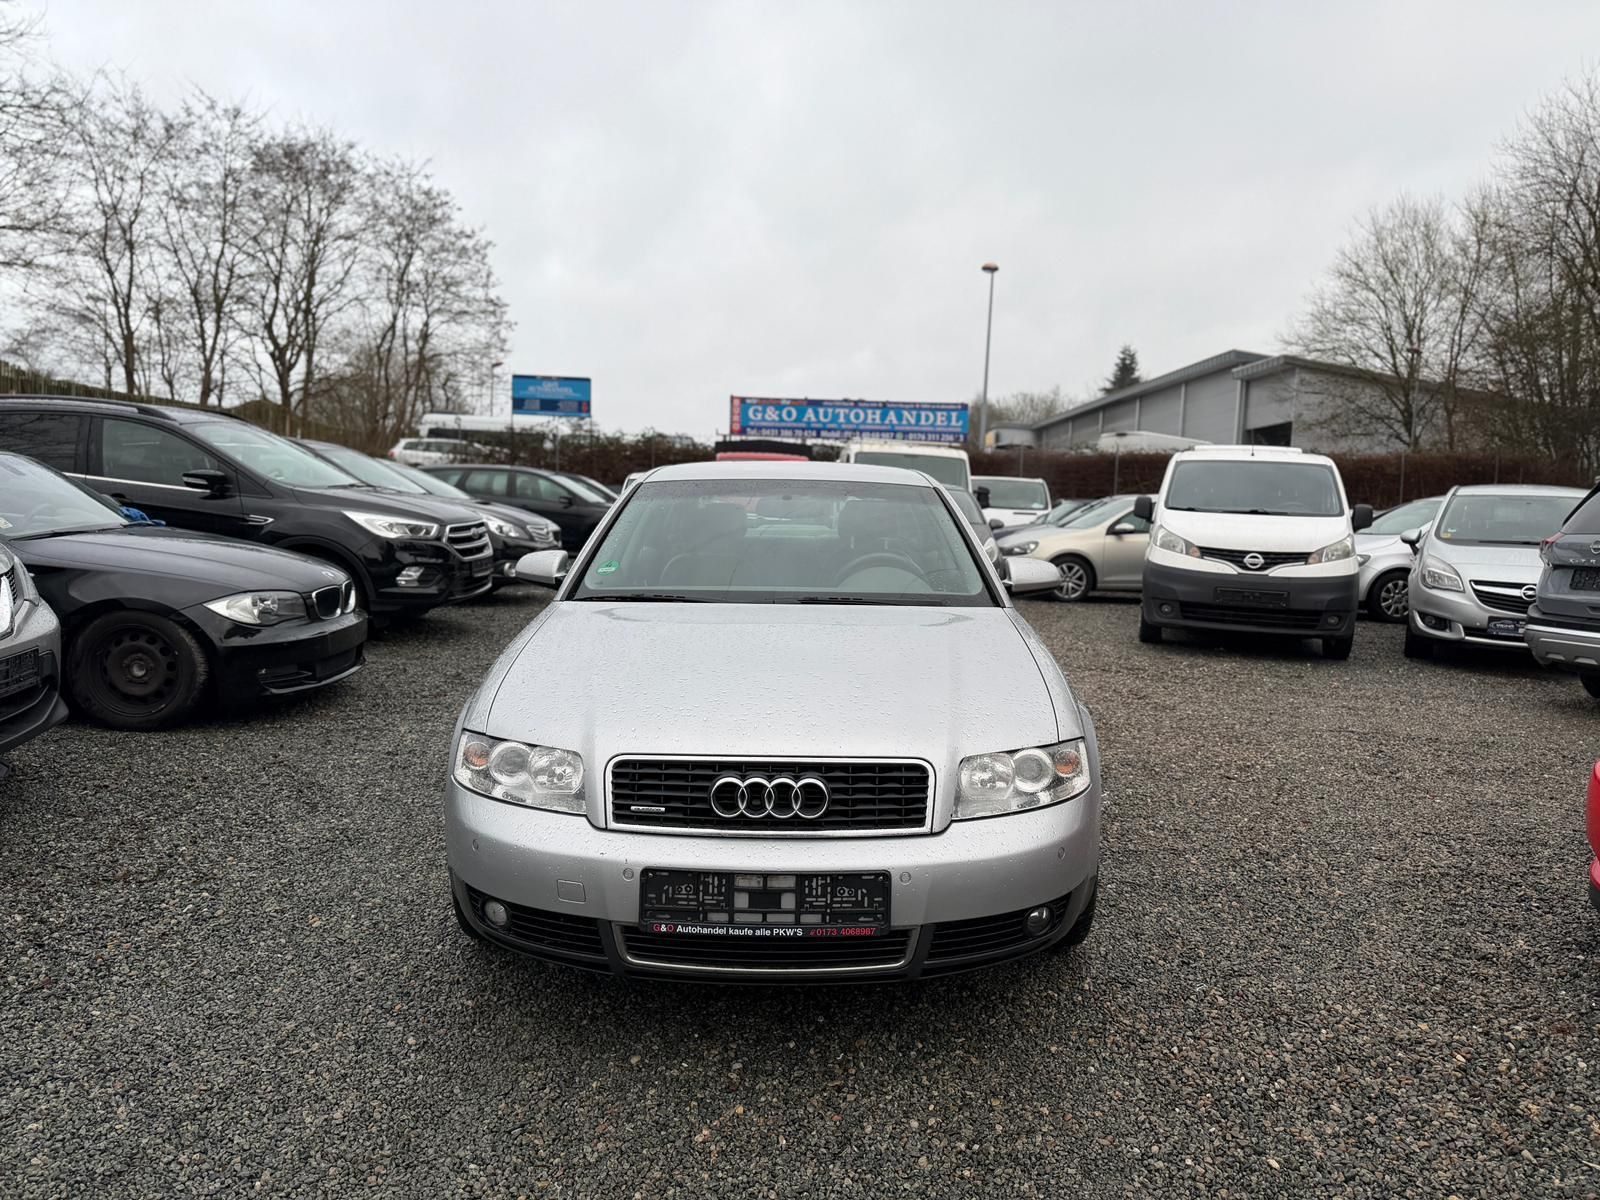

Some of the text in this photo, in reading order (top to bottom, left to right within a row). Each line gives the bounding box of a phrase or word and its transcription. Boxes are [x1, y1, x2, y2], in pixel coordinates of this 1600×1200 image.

[747, 405, 798, 421] G&O
[803, 407, 963, 427] AUTOHANDEL
[652, 923, 876, 937] G&O Autohandel kaufe alle PKW'S 0173 4068987
